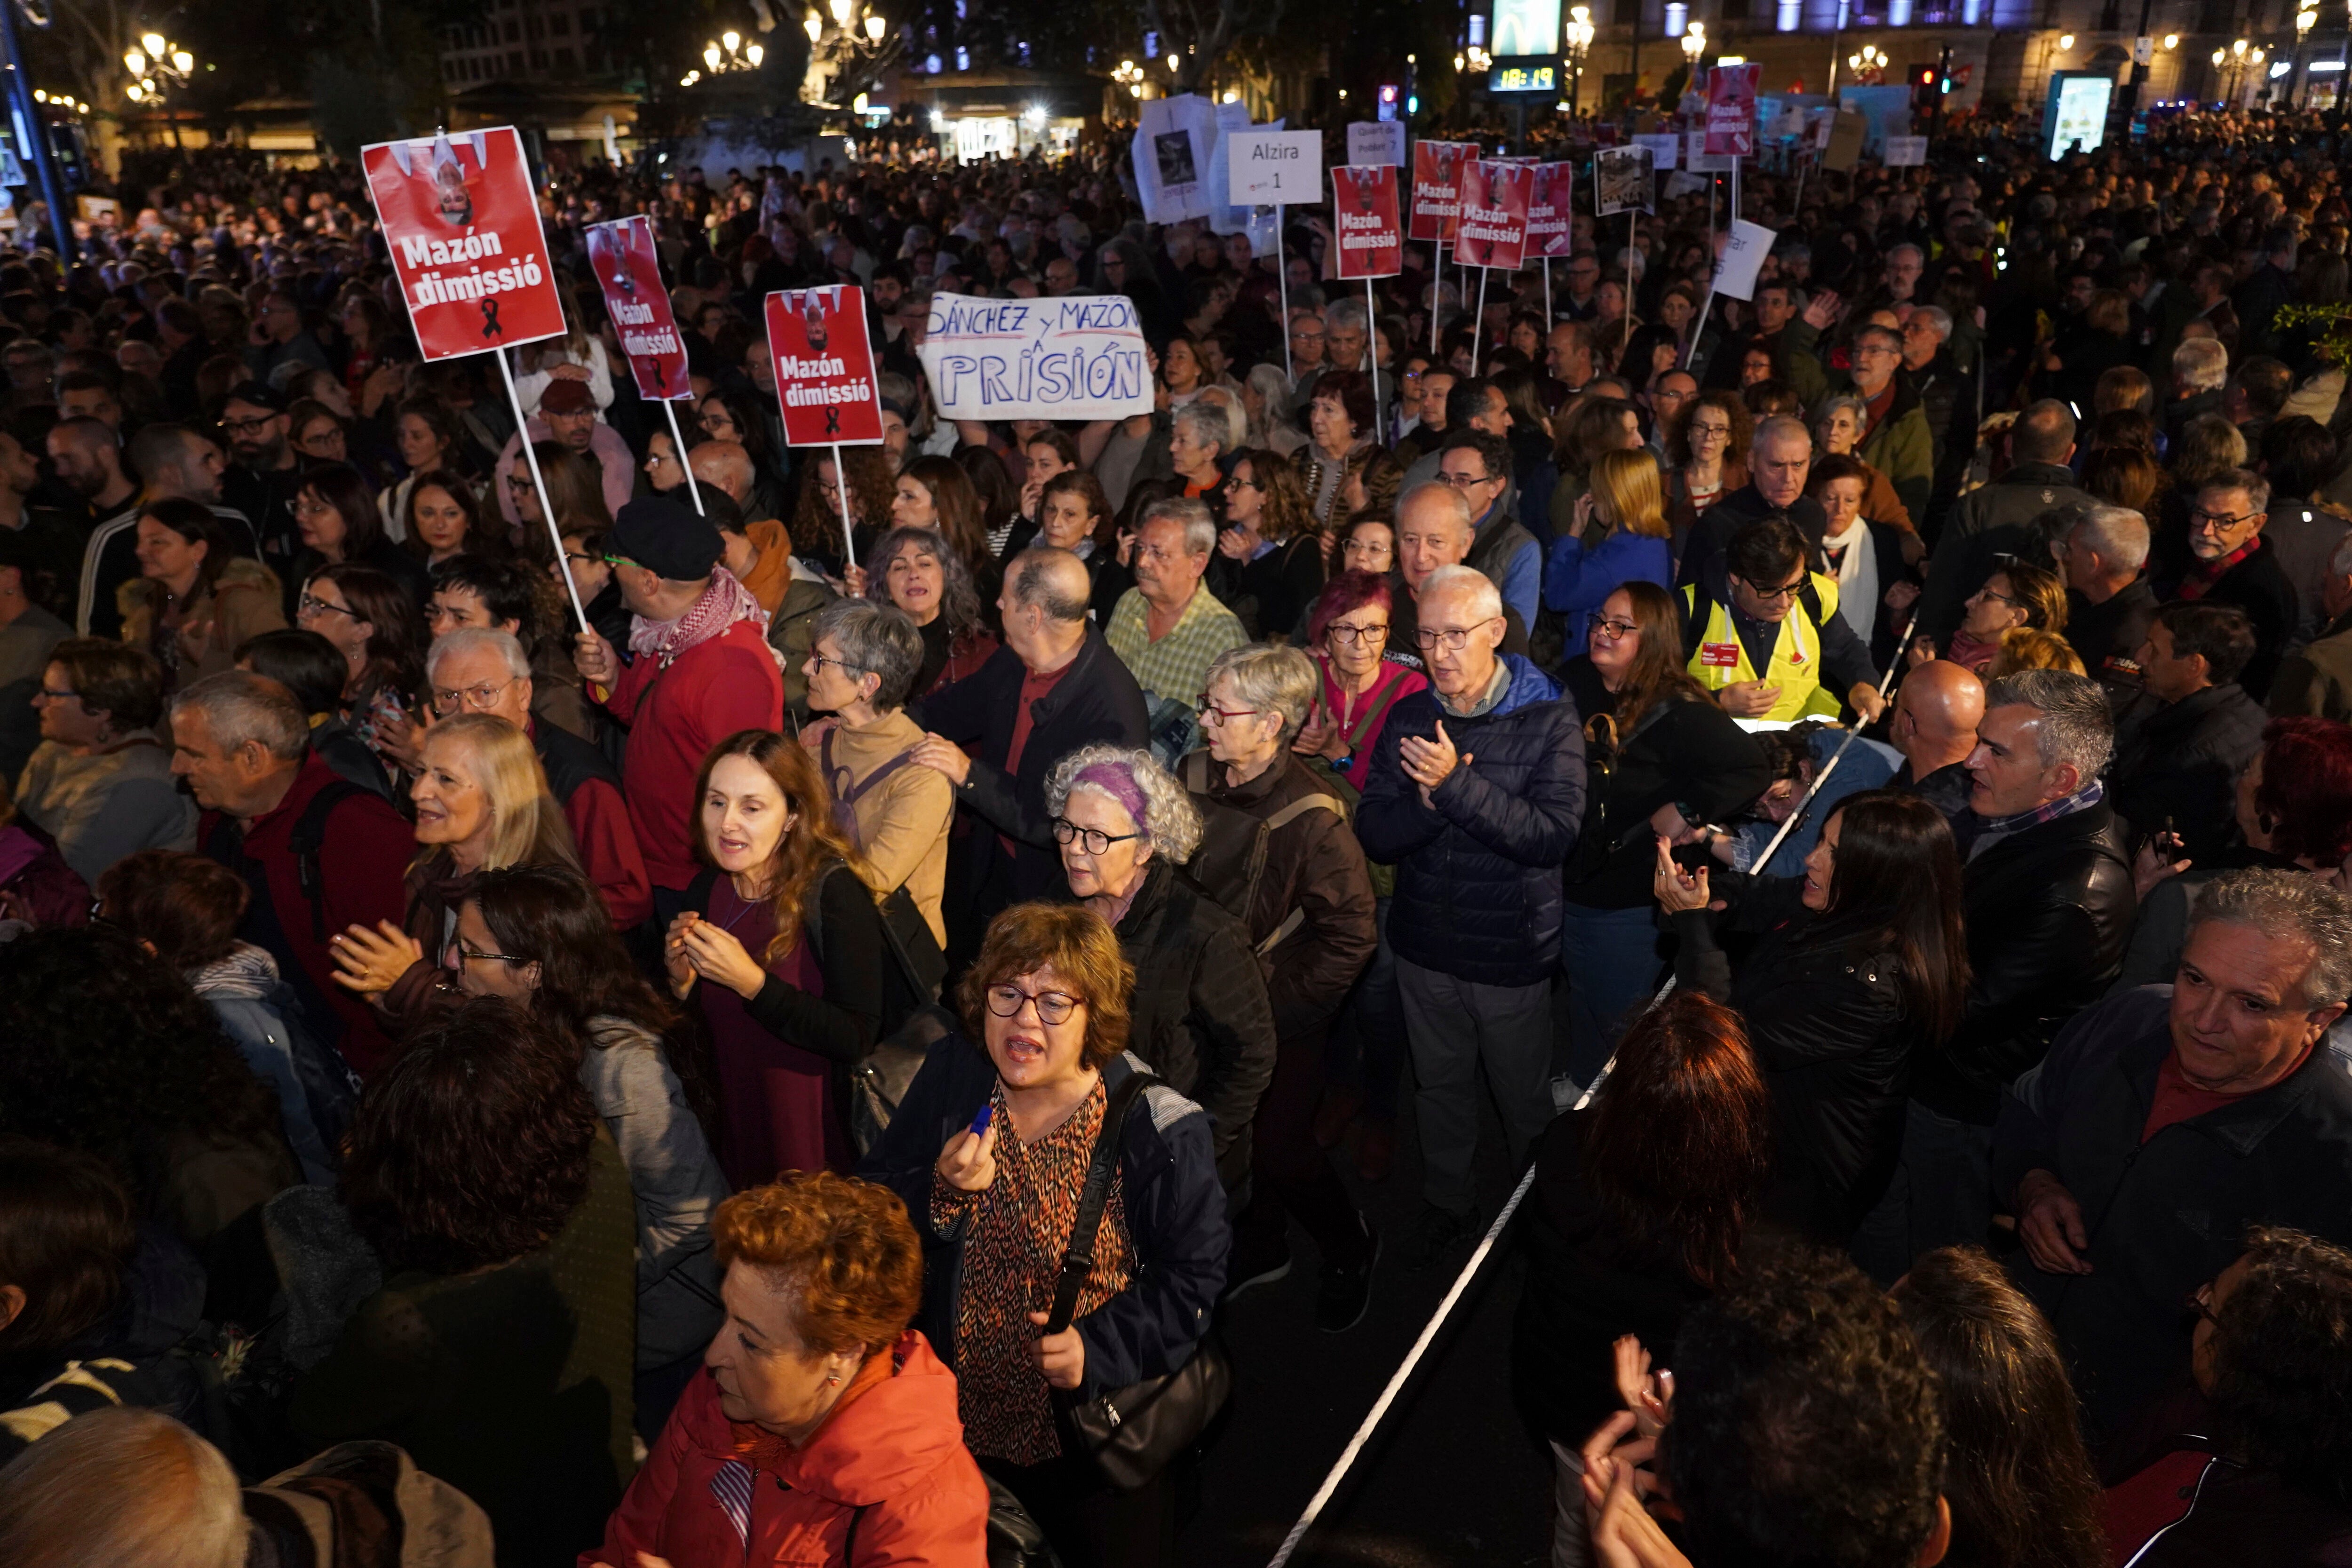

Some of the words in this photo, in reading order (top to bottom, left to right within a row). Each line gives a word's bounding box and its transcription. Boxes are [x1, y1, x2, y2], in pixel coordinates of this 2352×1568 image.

[1501, 68, 1553, 88] 18:19
[1252, 143, 1298, 160] Alzira
[1273, 173, 1281, 188] 1
[1418, 183, 1456, 199] Mazón
[1416, 199, 1461, 216] dimissi
[1463, 204, 1509, 223] Mazón
[1528, 202, 1555, 218] azón
[1342, 211, 1382, 230] Mazón
[1527, 218, 1566, 234] imissió
[1343, 230, 1397, 250] dimissió
[1461, 223, 1521, 244] dimissió
[400, 226, 502, 270] Mazón
[415, 254, 542, 306] dimissió
[611, 296, 655, 326] Mazón
[624, 326, 678, 356] dimissió
[1034, 339, 1044, 353] A
[780, 352, 845, 380] Mazón
[786, 377, 870, 407] dimissió
